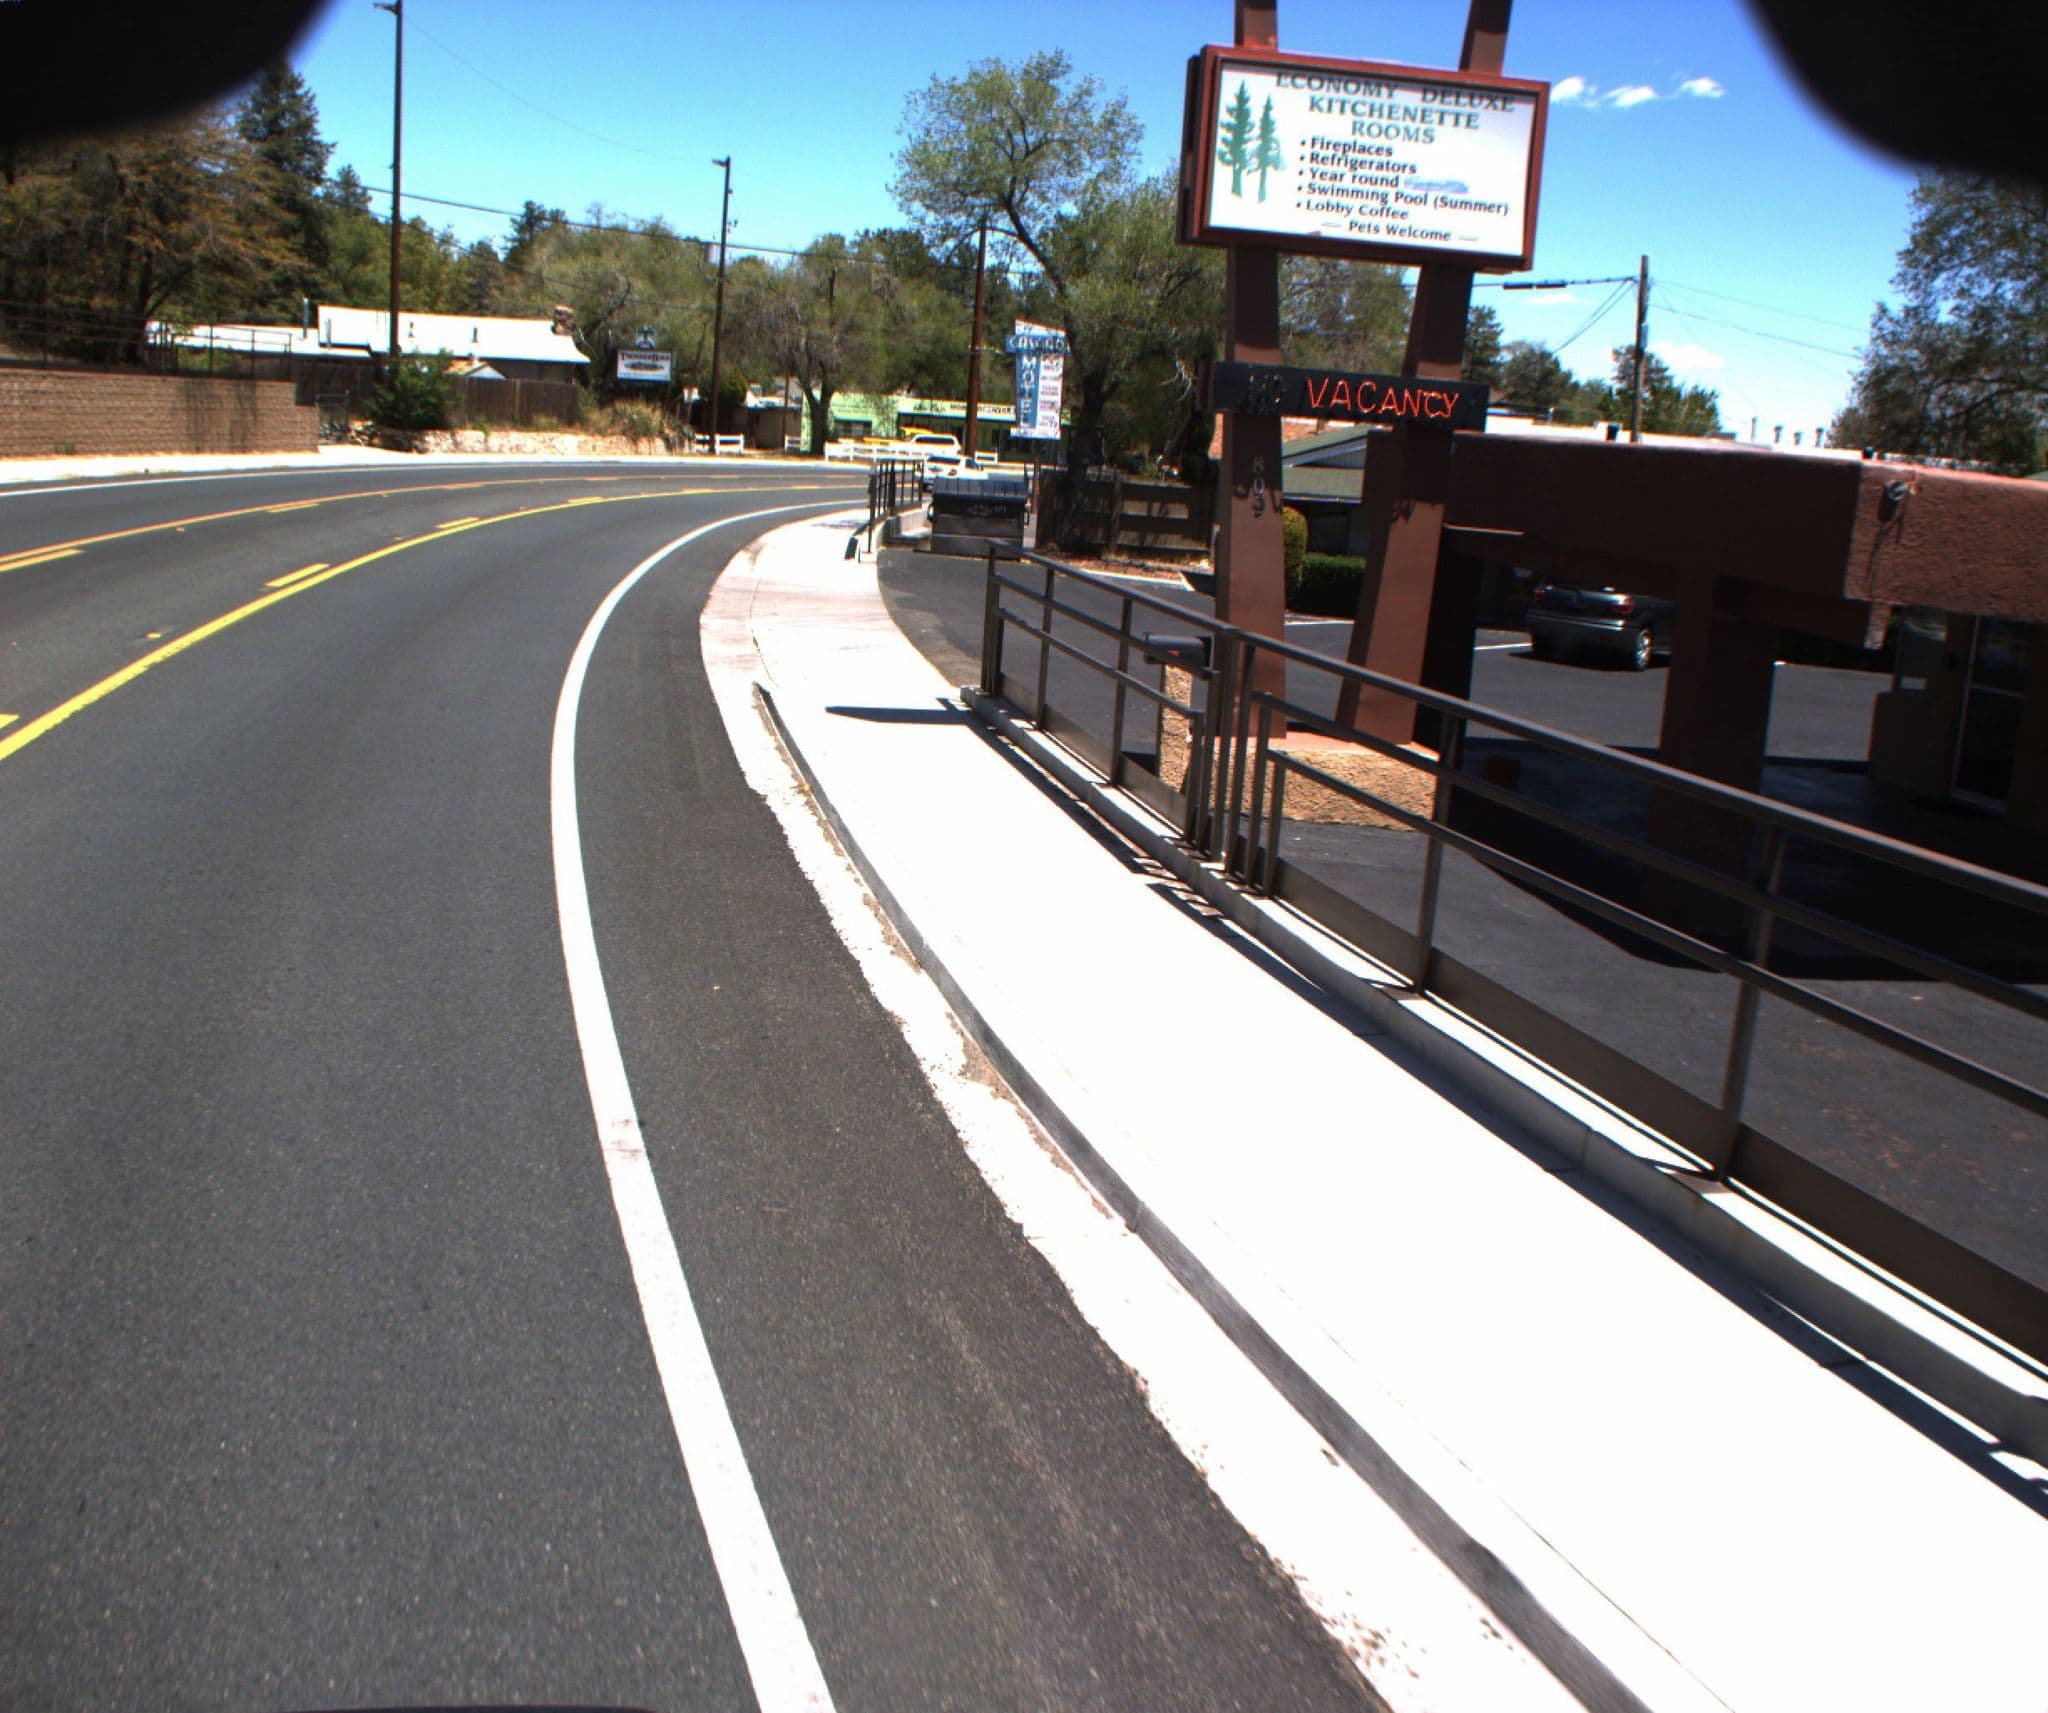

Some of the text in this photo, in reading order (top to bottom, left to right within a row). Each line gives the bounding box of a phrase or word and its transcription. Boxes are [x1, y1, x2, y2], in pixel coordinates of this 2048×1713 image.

[1275, 71, 1516, 112] ECONOMY DELUXE
[1308, 96, 1480, 129] KITCHENETTE
[1350, 119, 1436, 144] ROOMS
[1310, 137, 1393, 158] Fireplaces
[1309, 153, 1417, 175] Refrigerators
[1309, 168, 1345, 183] Year
[1351, 172, 1400, 188] round
[1305, 200, 1409, 220] Lobby Coffee
[1306, 182, 1389, 206] Swimming
[1394, 191, 1429, 206] Pool
[1433, 194, 1509, 216] (Summer)
[1348, 219, 1452, 242] Pets Welcome
[1307, 378, 1460, 418] VACANCY
